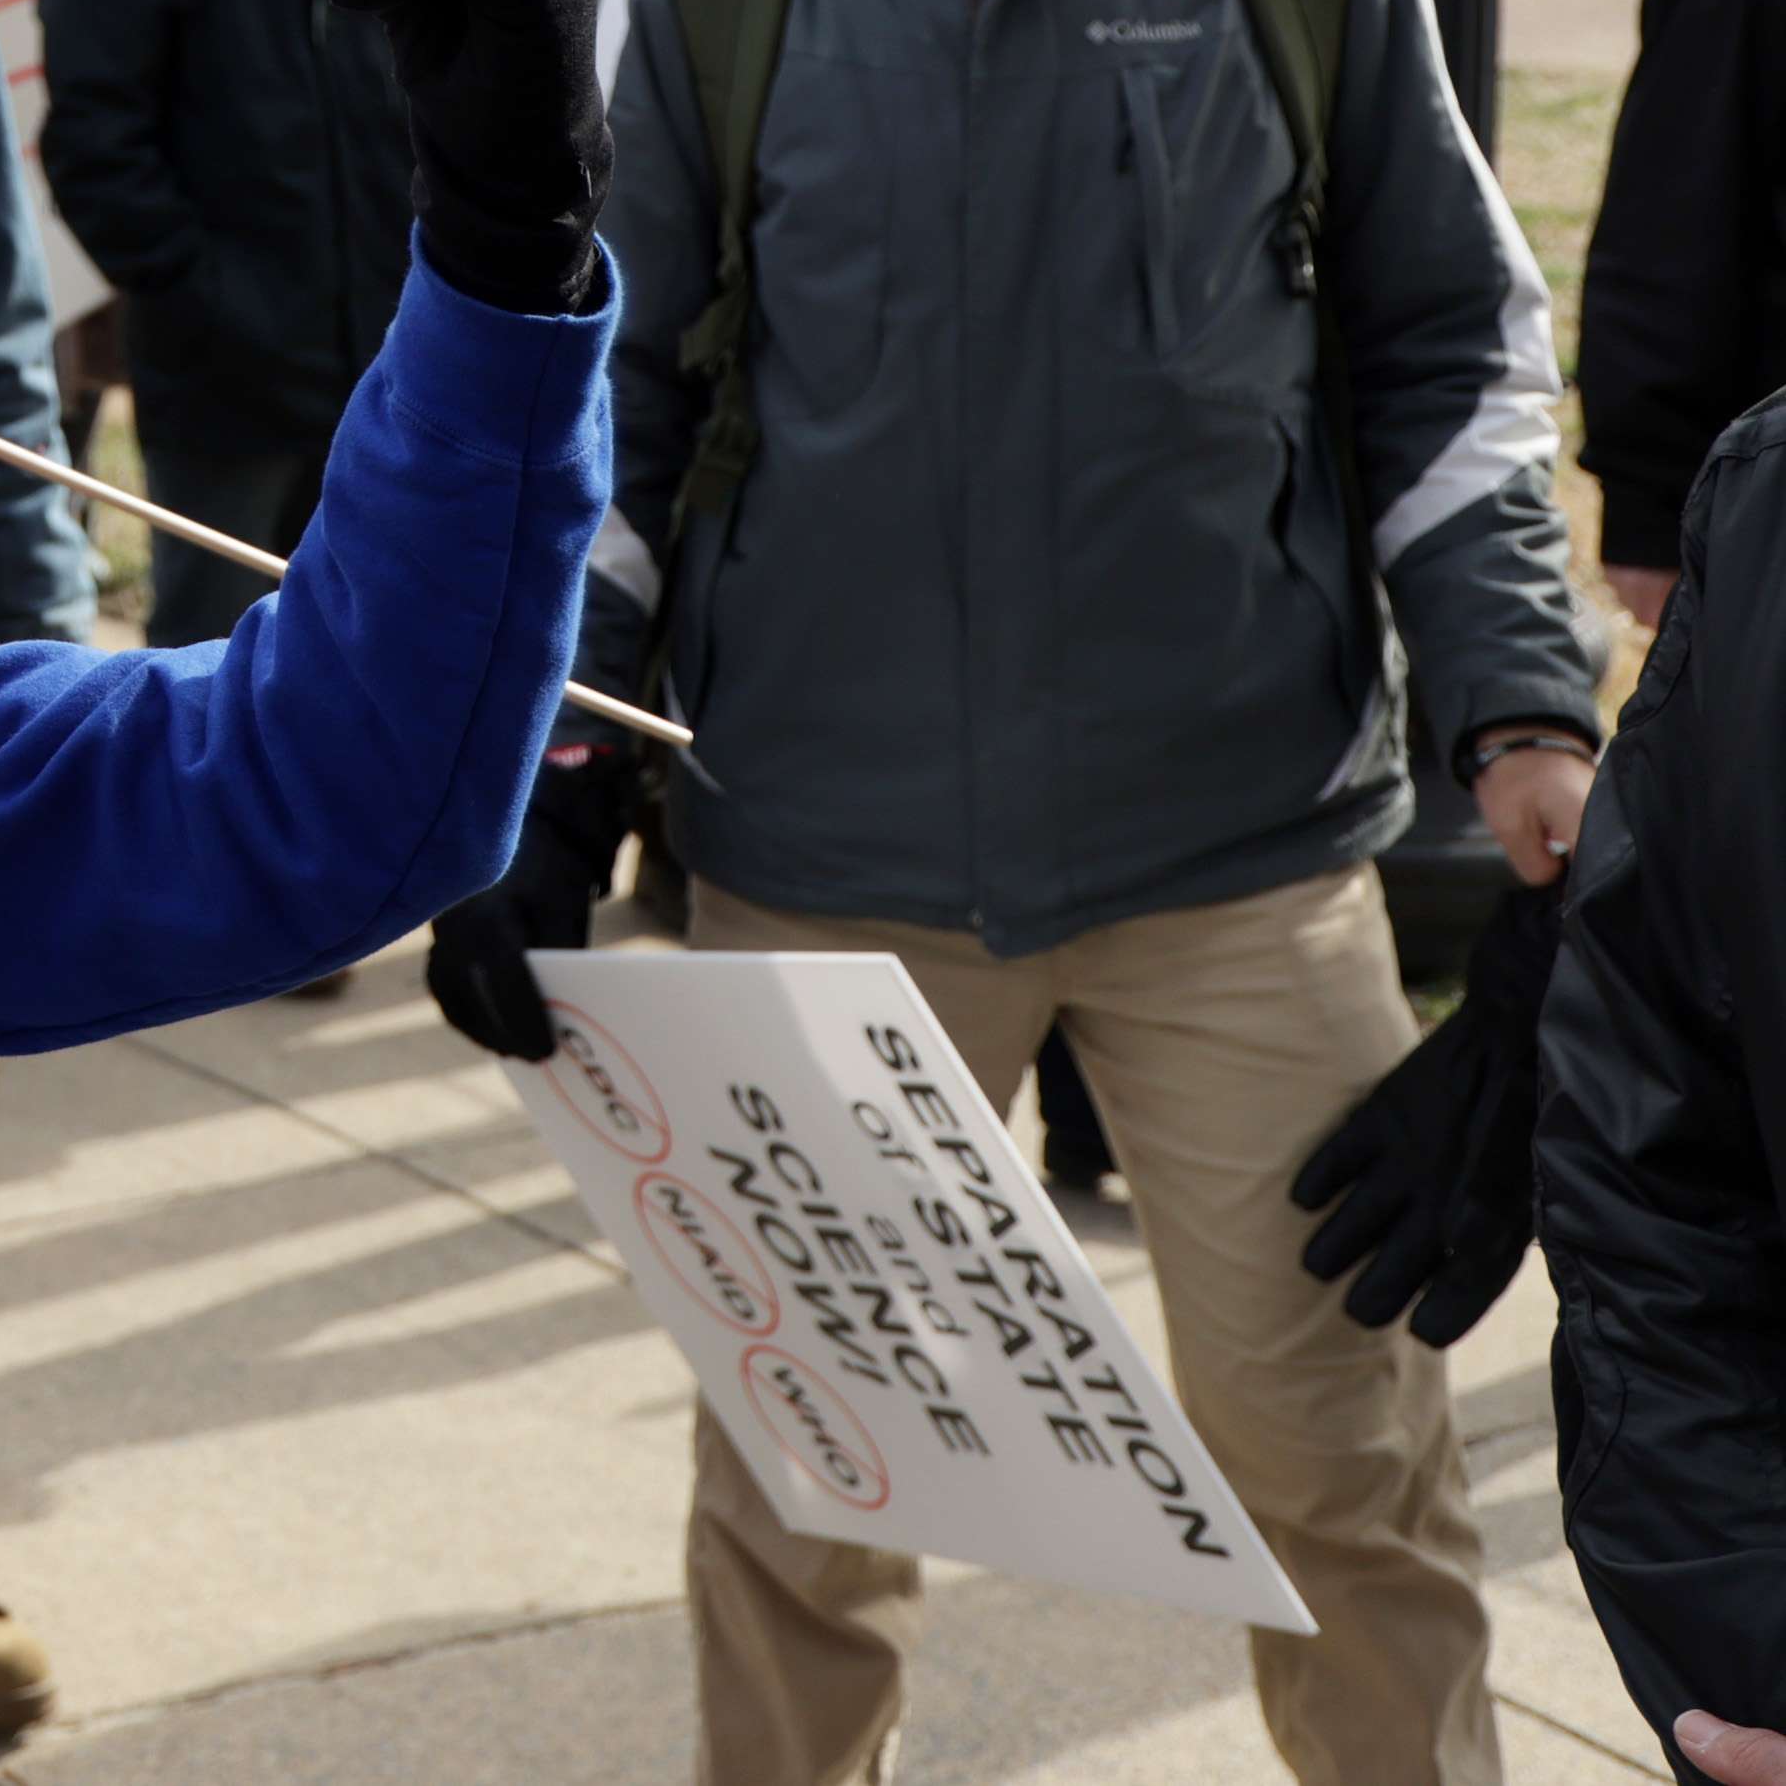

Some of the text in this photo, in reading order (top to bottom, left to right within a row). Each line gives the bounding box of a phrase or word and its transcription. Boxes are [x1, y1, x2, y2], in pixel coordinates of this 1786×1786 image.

[656, 1183, 757, 1323] NIAID
[772, 1366, 860, 1489] WHO
[705, 1144, 895, 1388] NOW!
[728, 1082, 994, 1458] SCIENCE
[851, 1100, 1117, 1469] of STATE
[865, 1022, 1233, 1561] SEPARATION
[866, 1213, 973, 1338] and
